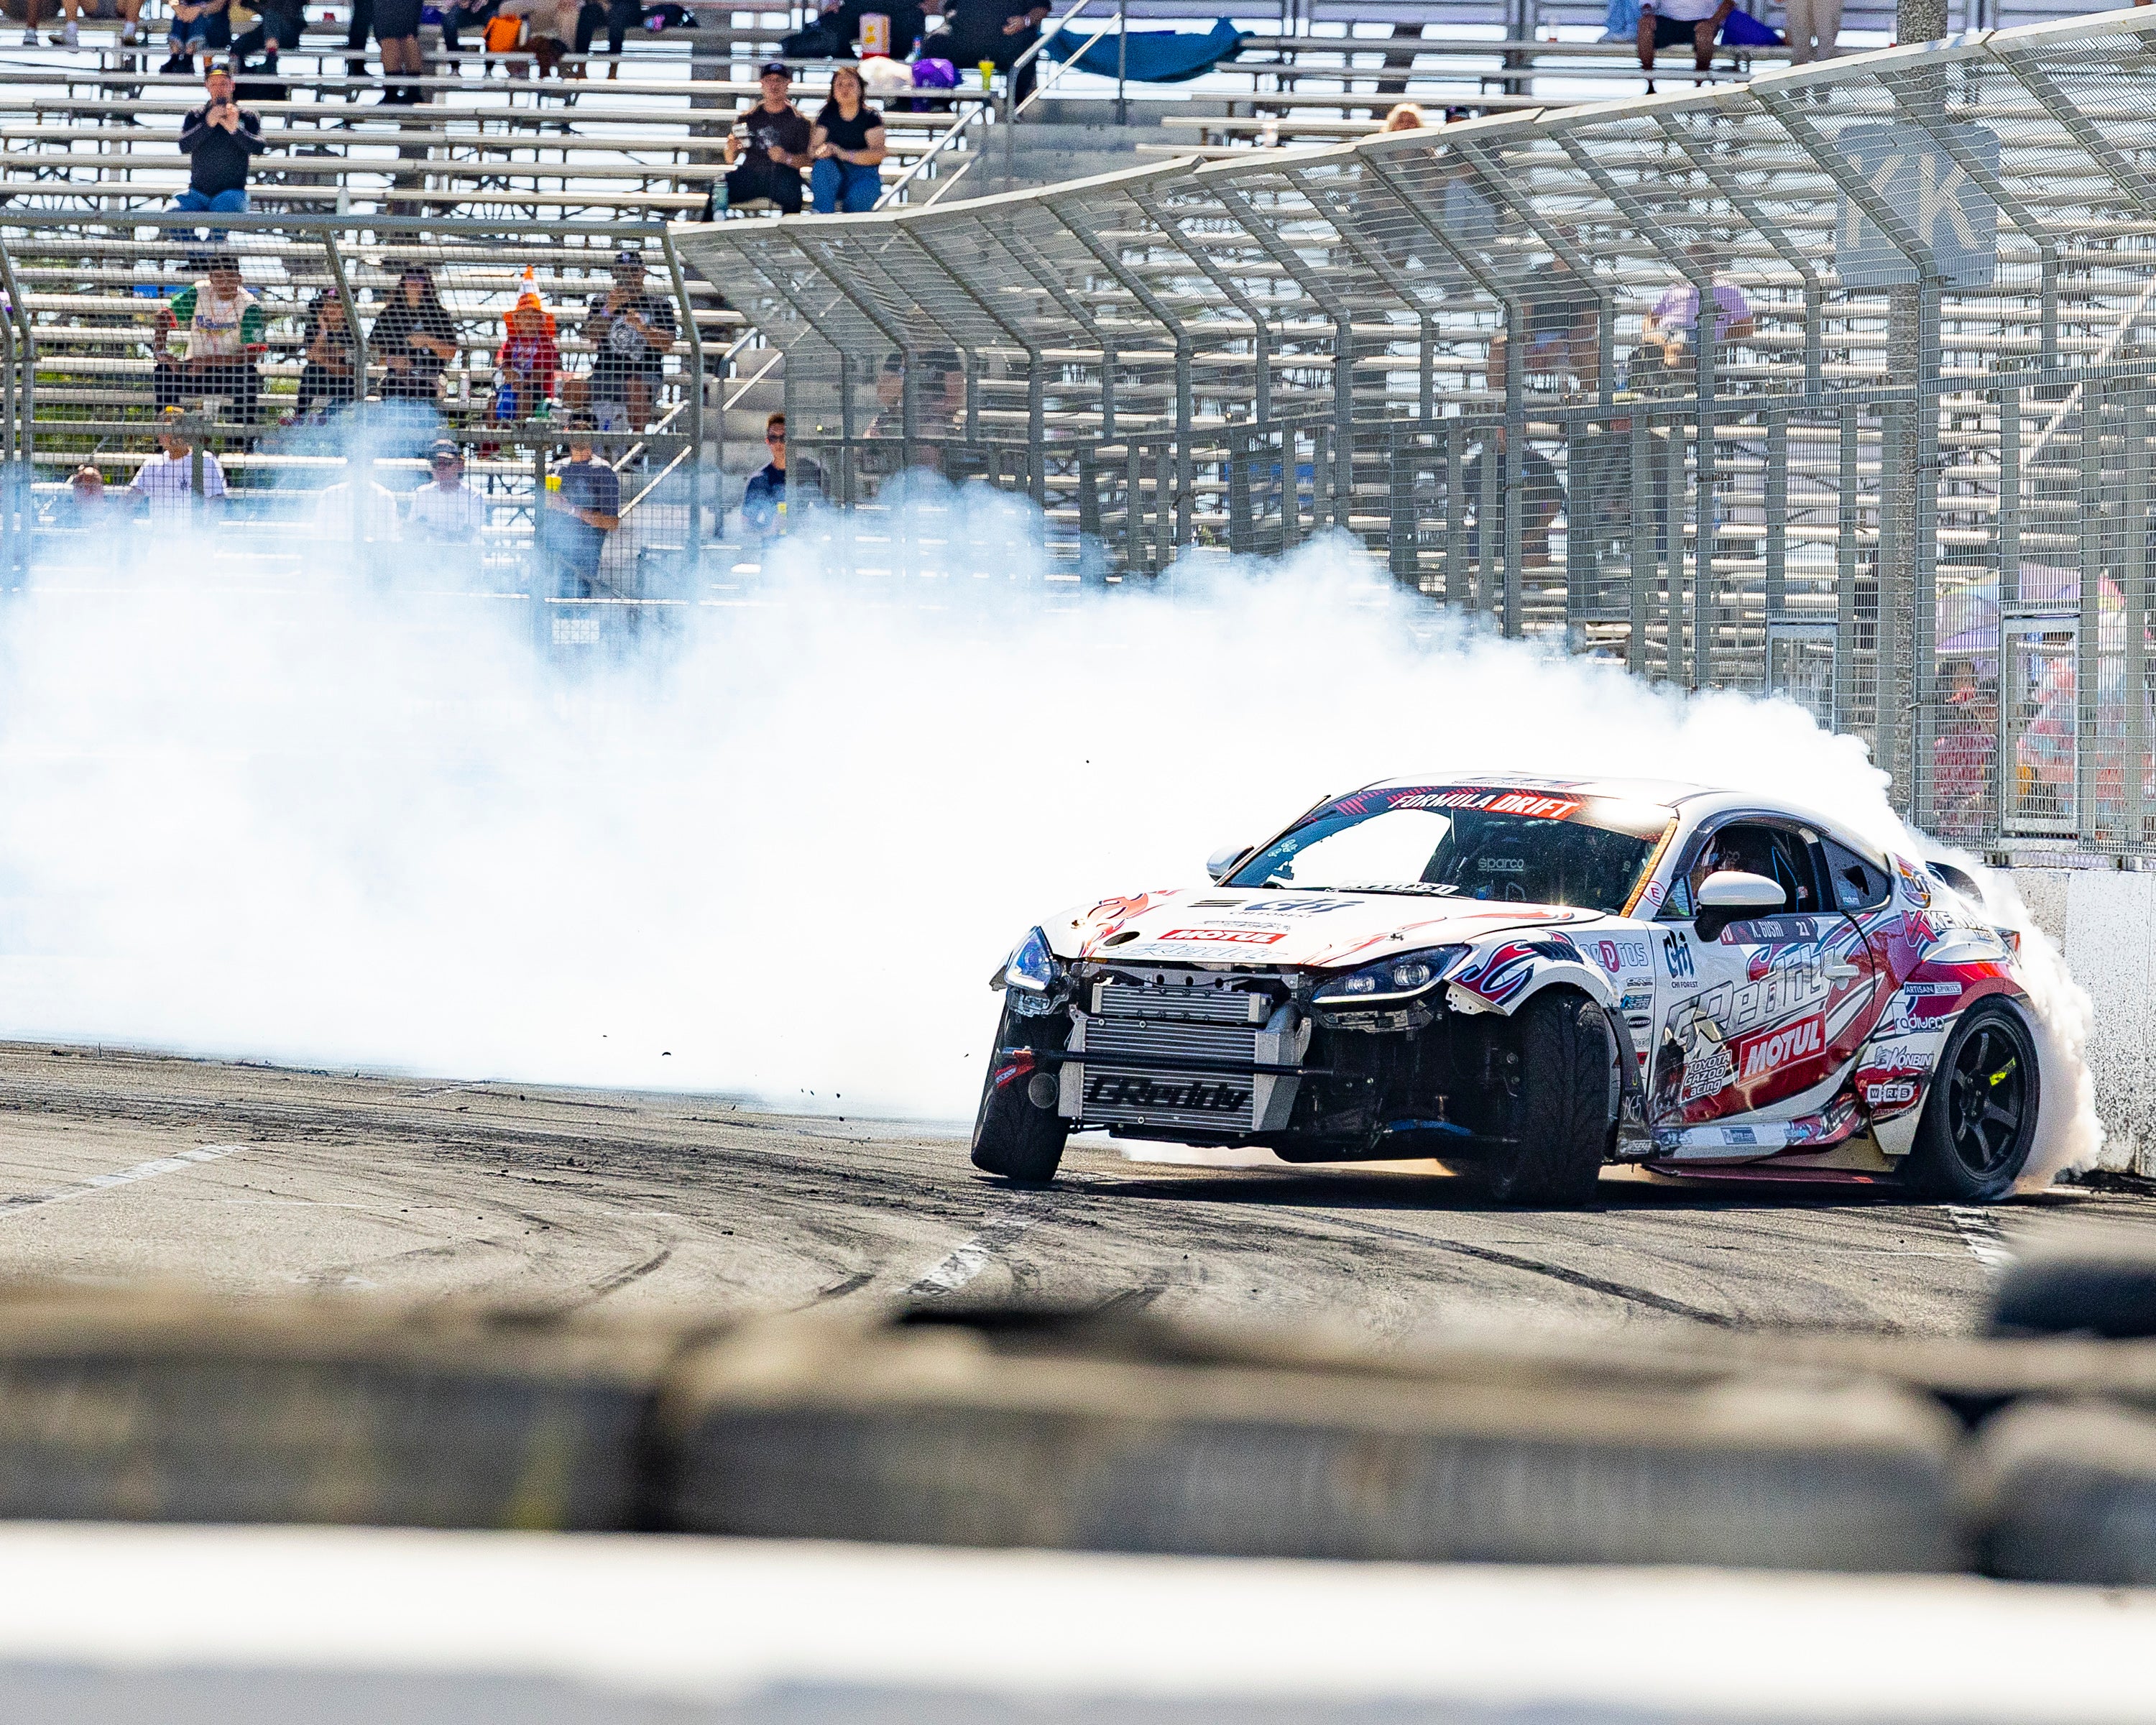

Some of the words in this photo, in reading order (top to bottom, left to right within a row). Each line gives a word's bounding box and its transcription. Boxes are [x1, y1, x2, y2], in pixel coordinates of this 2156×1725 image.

[1388, 794, 1496, 809] FORMULA
[1490, 795, 1580, 817] DRIFT
[1478, 857, 1524, 872] sparco
[1651, 887, 1660, 900] E
[1164, 930, 1276, 943] MOTUL
[1748, 921, 1761, 938] K.
[1759, 921, 1784, 937] GUSHI
[1906, 984, 1934, 994] ARTISAN
[1935, 984, 1961, 993] SPIRITS
[1895, 1013, 1943, 1029] radium
[1743, 1019, 1821, 1078] MOTUL
[1689, 1052, 1731, 1073] TOYOTA
[1685, 1066, 1725, 1087] GAZOO
[1682, 1080, 1721, 1101] Racing
